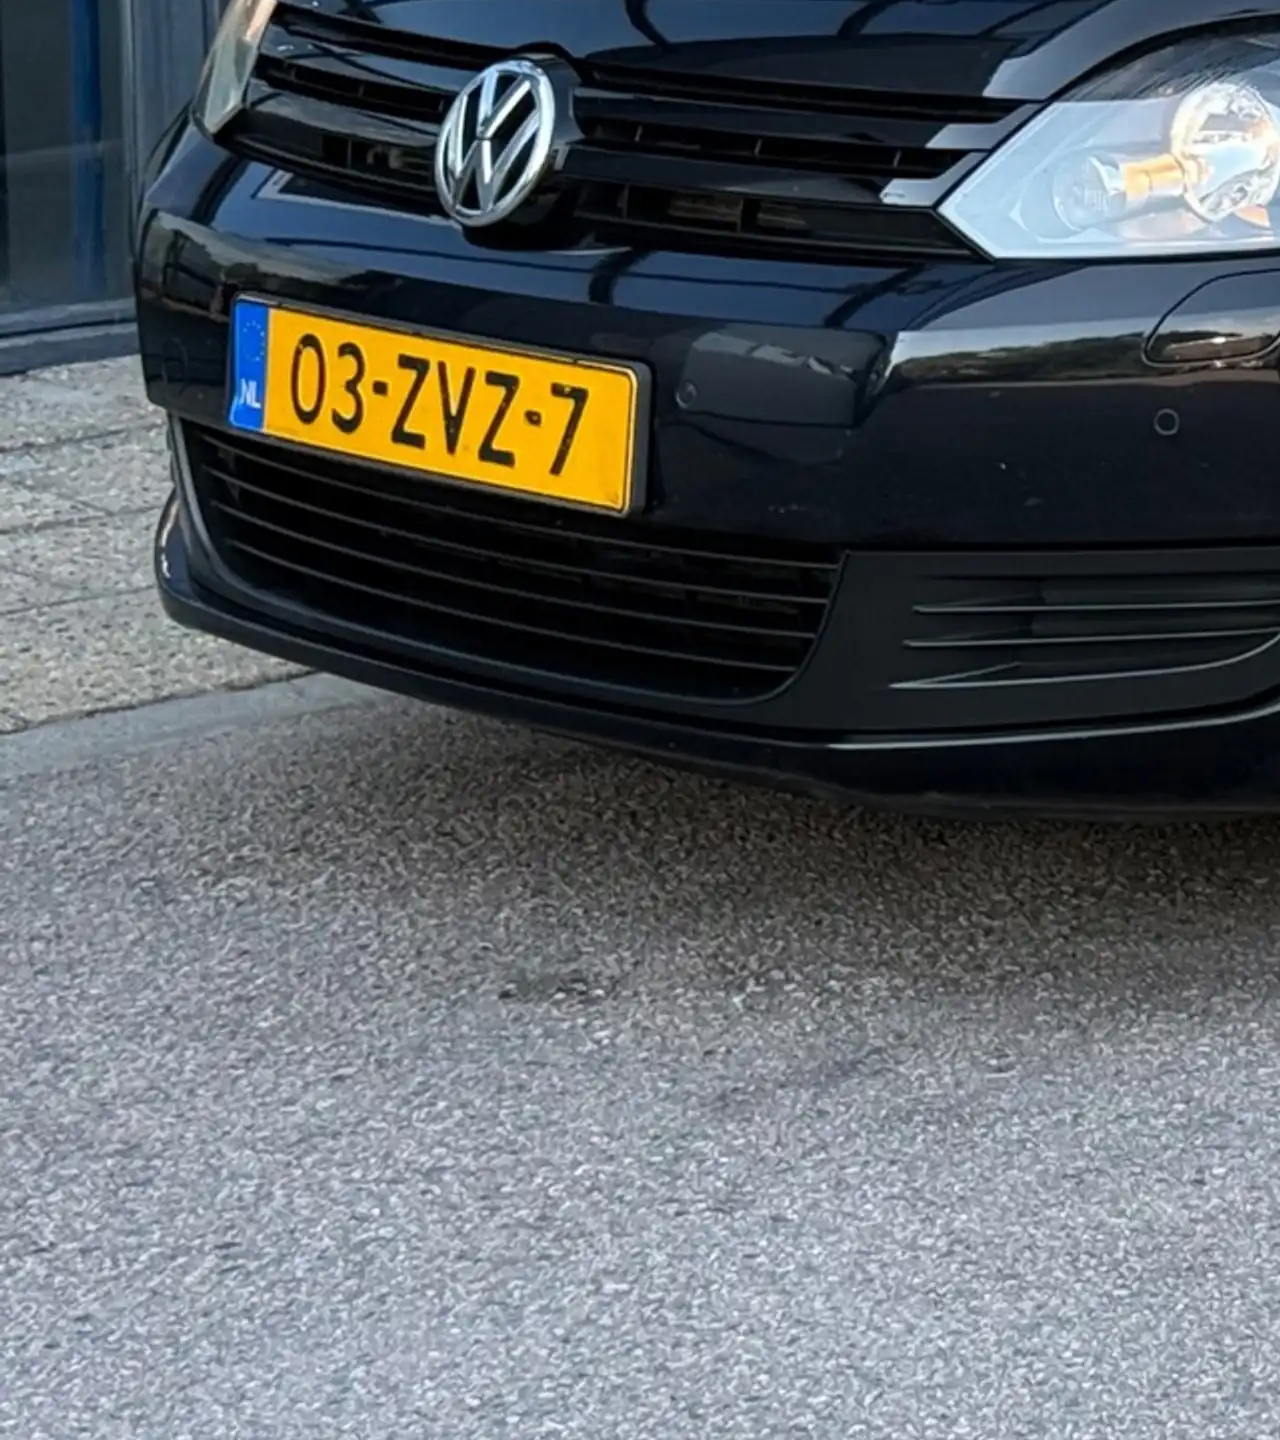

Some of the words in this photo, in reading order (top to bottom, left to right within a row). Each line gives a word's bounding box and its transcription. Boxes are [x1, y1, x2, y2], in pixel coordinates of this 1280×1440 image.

[436, 59, 556, 227] VW
[239, 377, 261, 409] NL
[290, 333, 590, 477] 03-ZVZ-7
